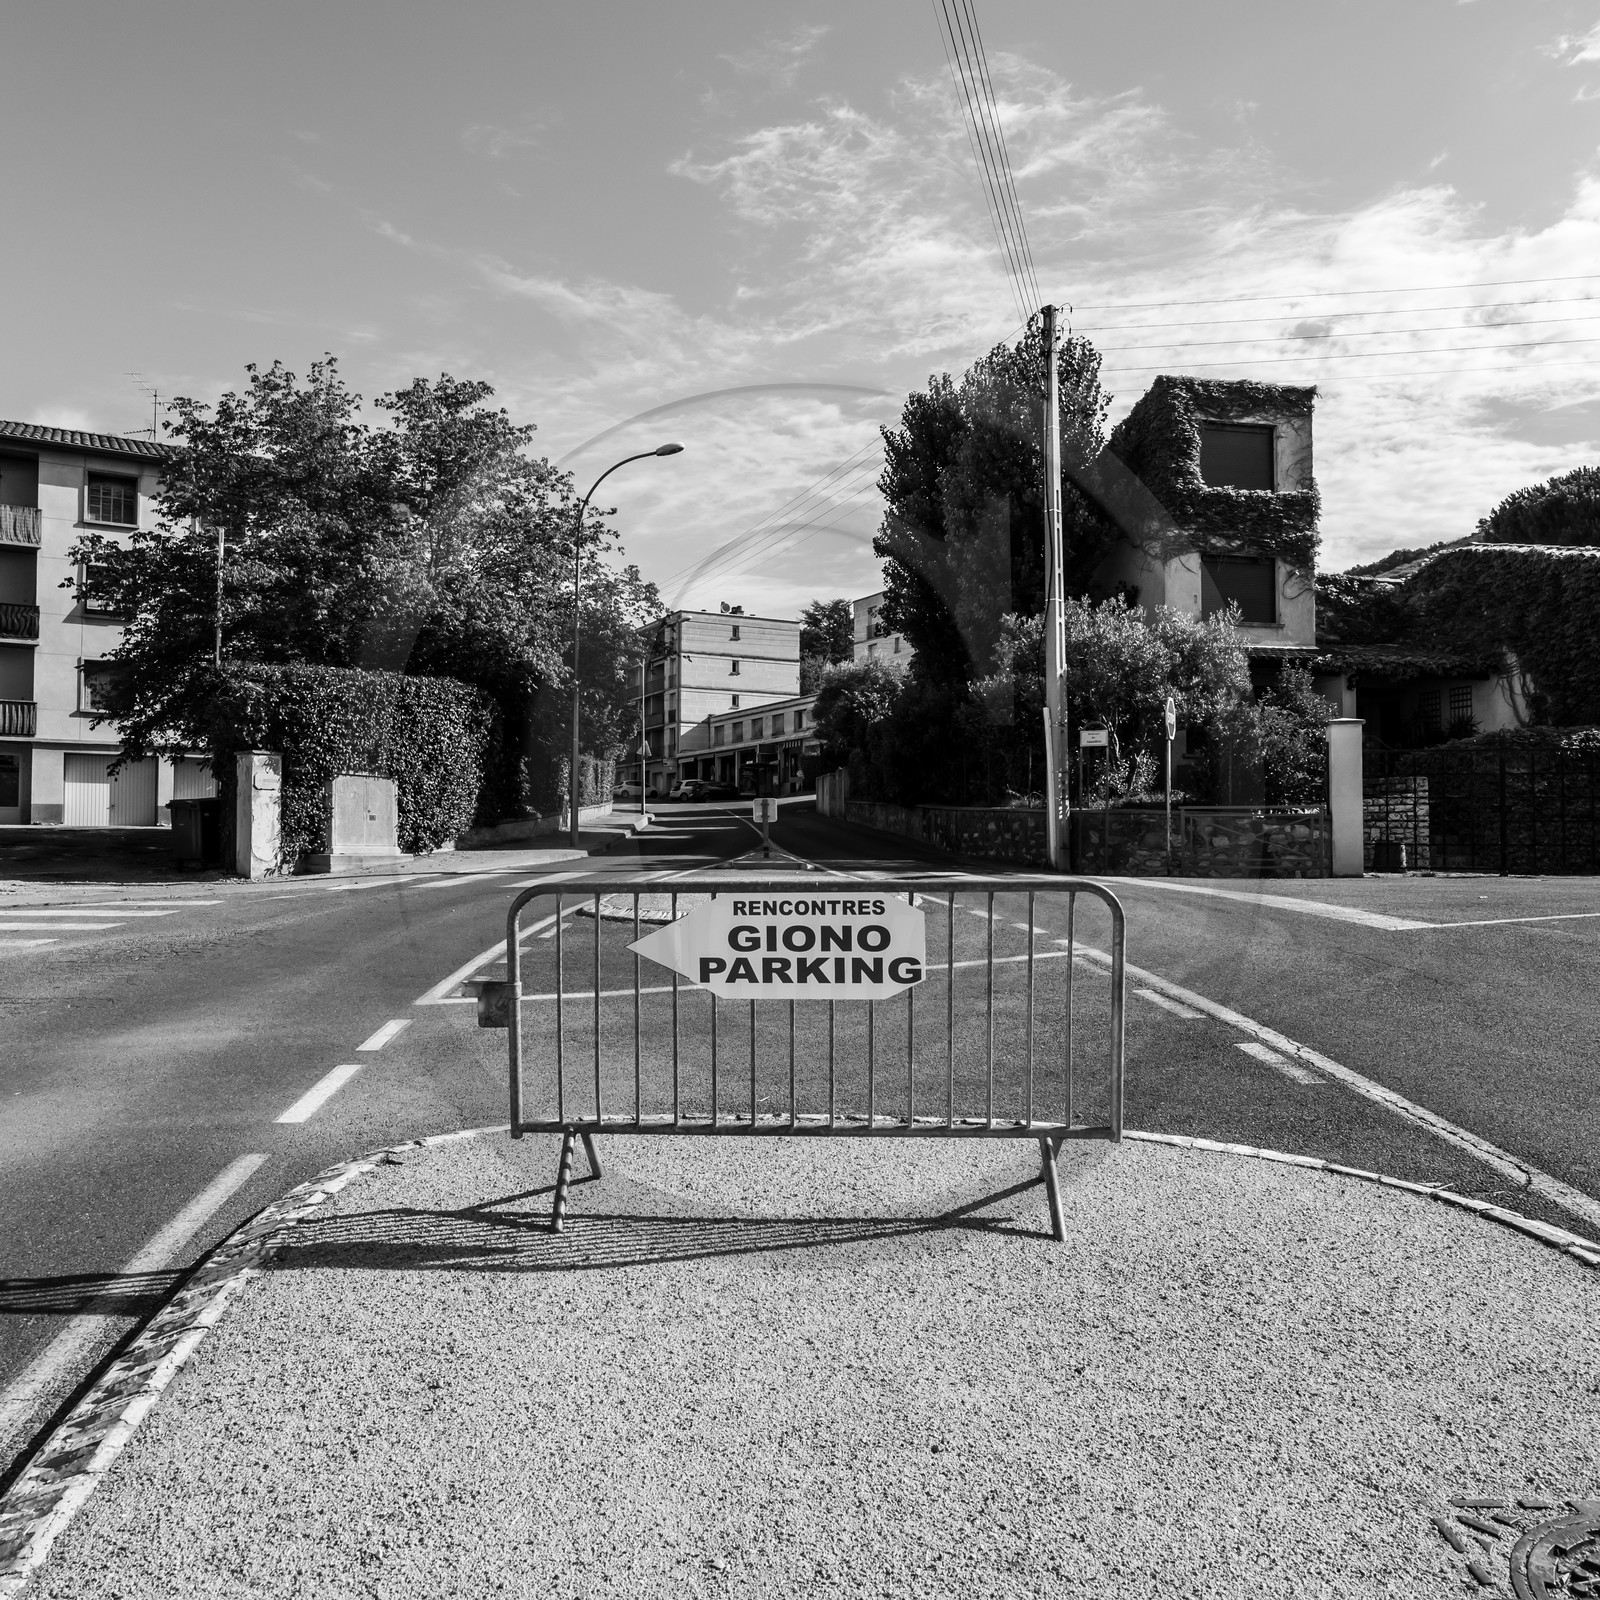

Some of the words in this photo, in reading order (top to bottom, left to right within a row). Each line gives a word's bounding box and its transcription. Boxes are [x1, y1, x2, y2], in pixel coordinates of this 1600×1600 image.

[733, 900, 886, 916] RENCONTRES
[728, 925, 891, 952] GIONO
[700, 957, 922, 984] PARKING
